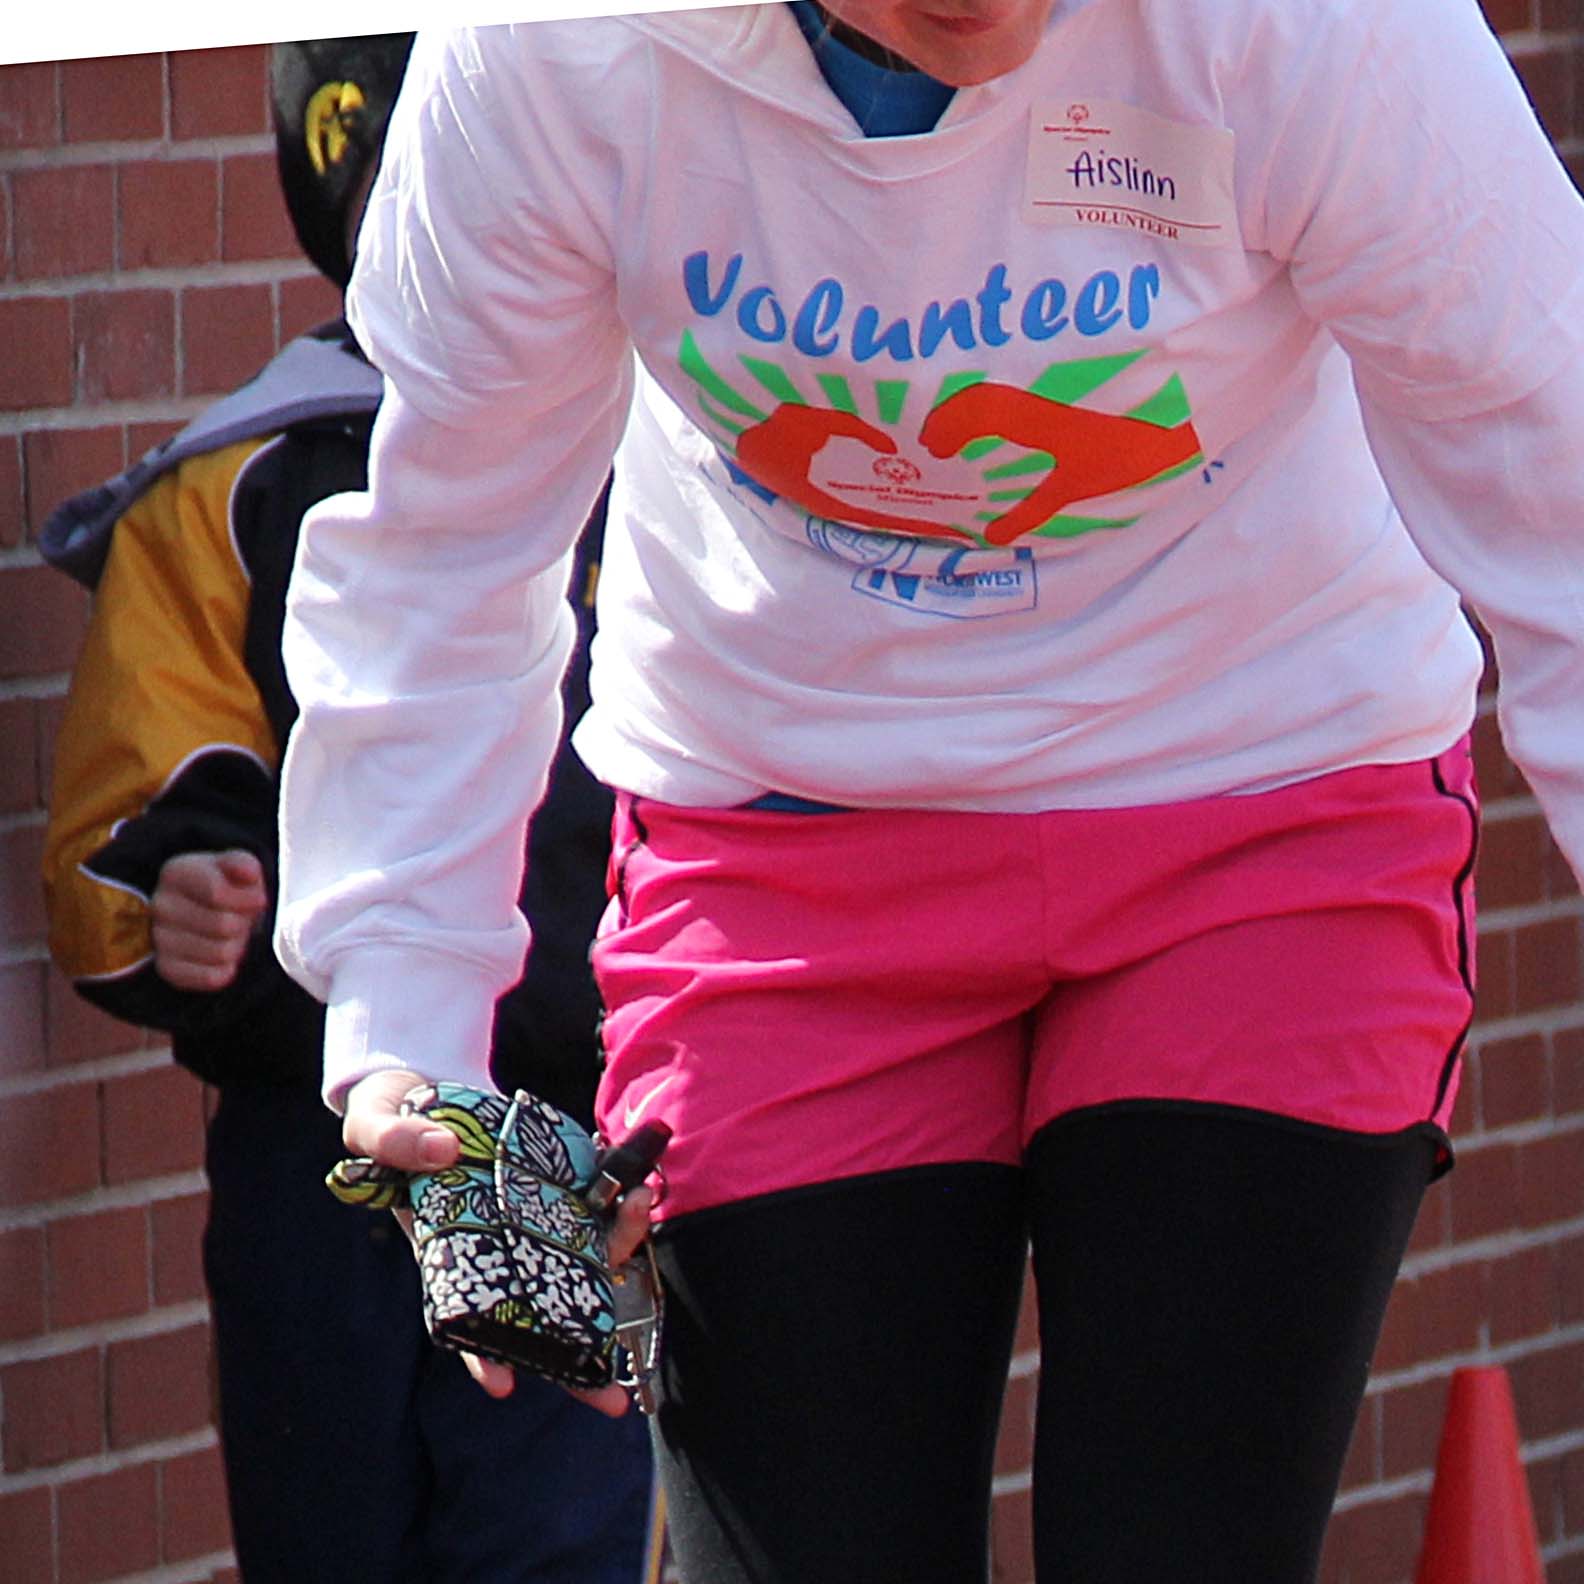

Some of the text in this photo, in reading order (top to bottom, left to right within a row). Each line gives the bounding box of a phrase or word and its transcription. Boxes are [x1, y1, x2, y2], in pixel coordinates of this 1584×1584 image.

[1066, 149, 1176, 200] Aislinn
[1076, 208, 1180, 240] VOLUNTEER
[683, 249, 1161, 364] Volunteer
